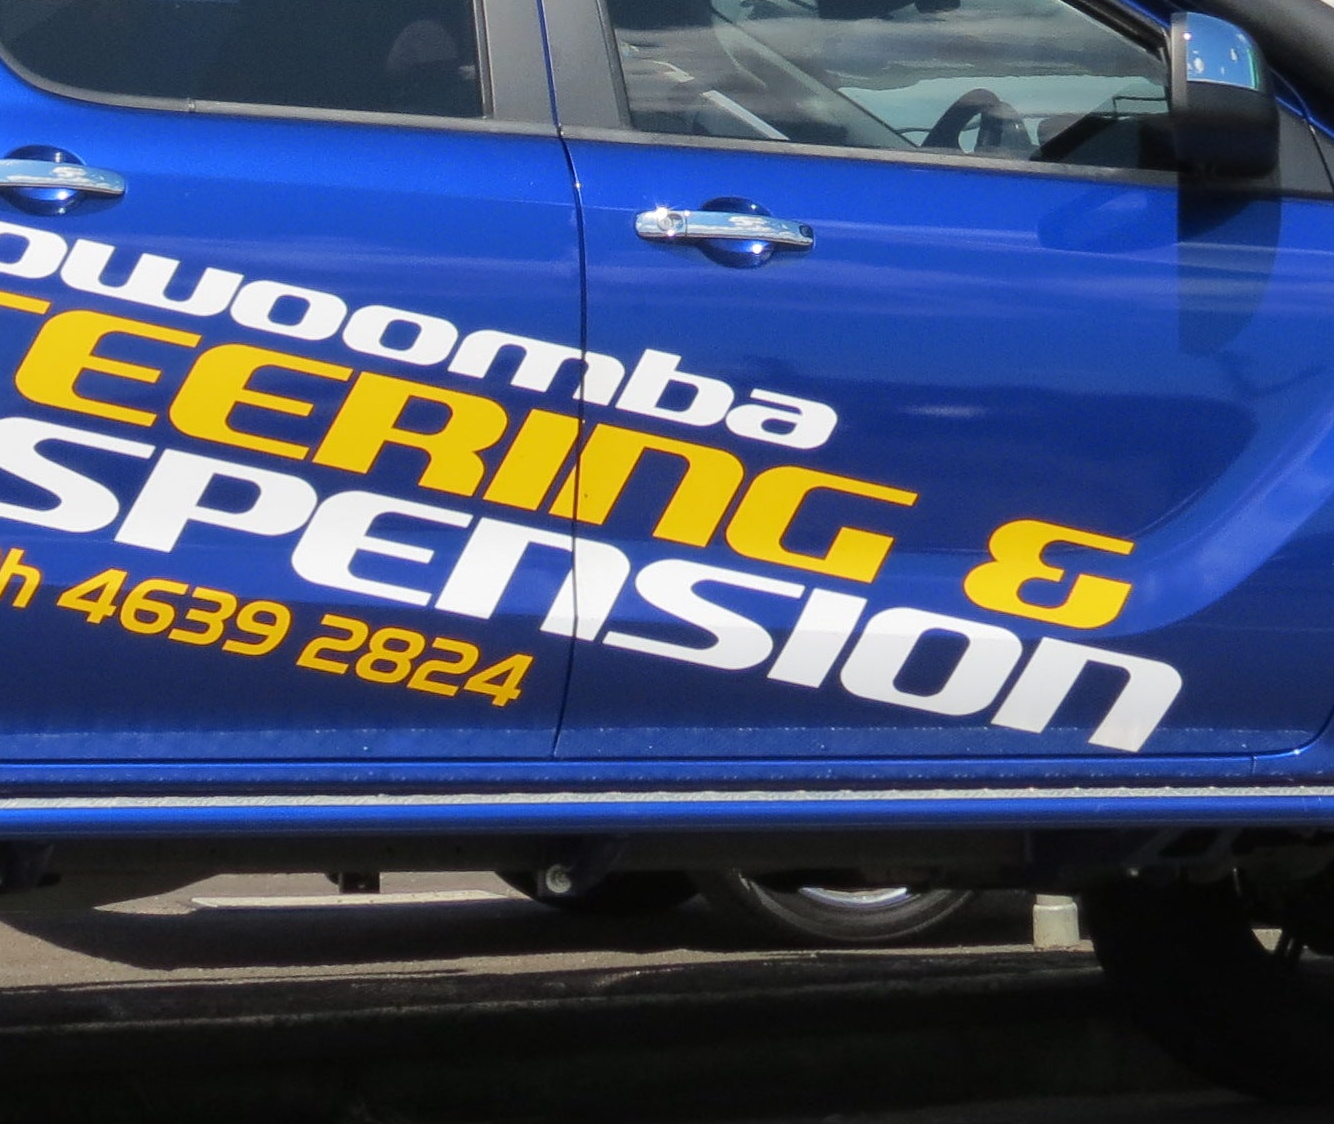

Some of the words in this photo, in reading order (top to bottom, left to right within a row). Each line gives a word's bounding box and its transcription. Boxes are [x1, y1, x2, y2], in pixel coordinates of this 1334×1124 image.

[57, 566, 291, 658] 4639
[294, 612, 535, 708] 2824
[962, 519, 1136, 630] &
